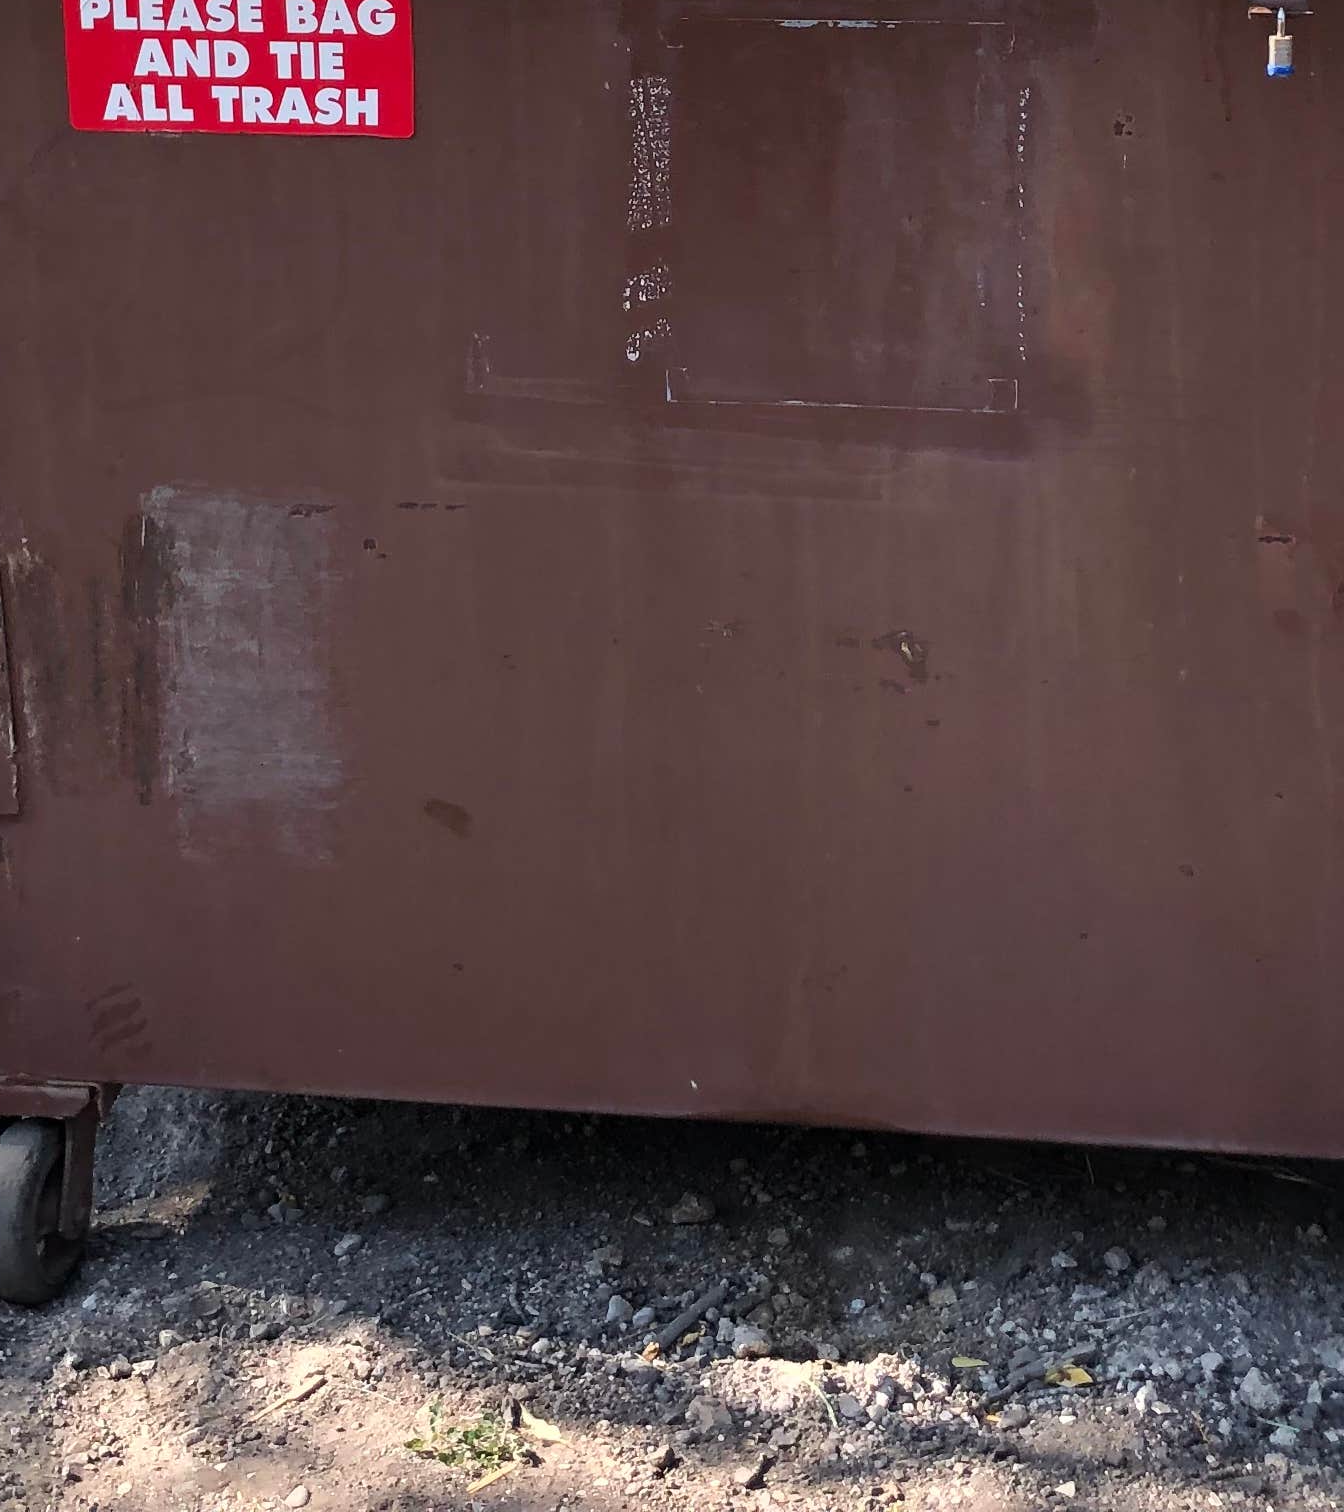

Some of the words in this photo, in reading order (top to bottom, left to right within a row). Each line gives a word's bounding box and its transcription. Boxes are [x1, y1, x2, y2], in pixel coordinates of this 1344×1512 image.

[133, 38, 250, 78] AND
[269, 41, 345, 80] TIE
[103, 83, 194, 122] ALL
[211, 85, 379, 126] TRASH
